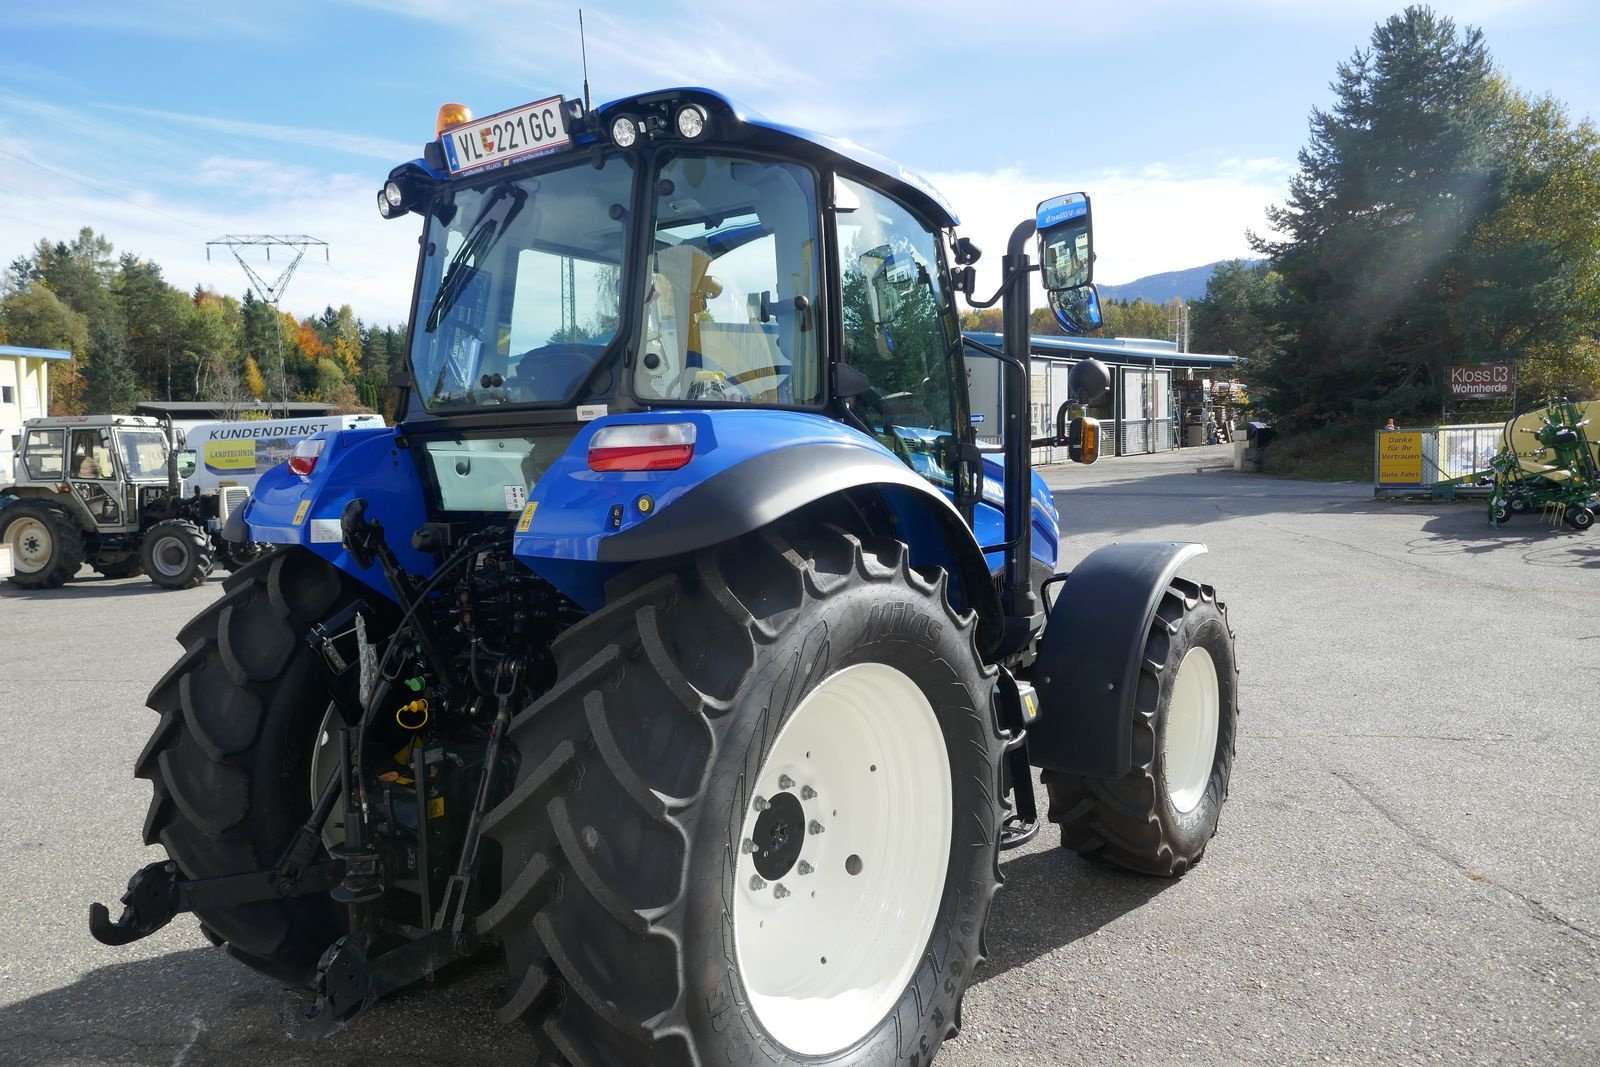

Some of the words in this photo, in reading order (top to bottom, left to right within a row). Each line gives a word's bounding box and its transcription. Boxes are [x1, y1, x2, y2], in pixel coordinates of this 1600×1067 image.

[459, 132, 483, 162] VL
[493, 109, 557, 153] 221GC
[1451, 367, 1491, 383] Kloss
[1452, 383, 1508, 393] Wohnherde
[209, 424, 328, 440] KUNDENDIENST
[210, 449, 255, 459] LANDTECHNIK
[864, 602, 944, 643] Mitas
